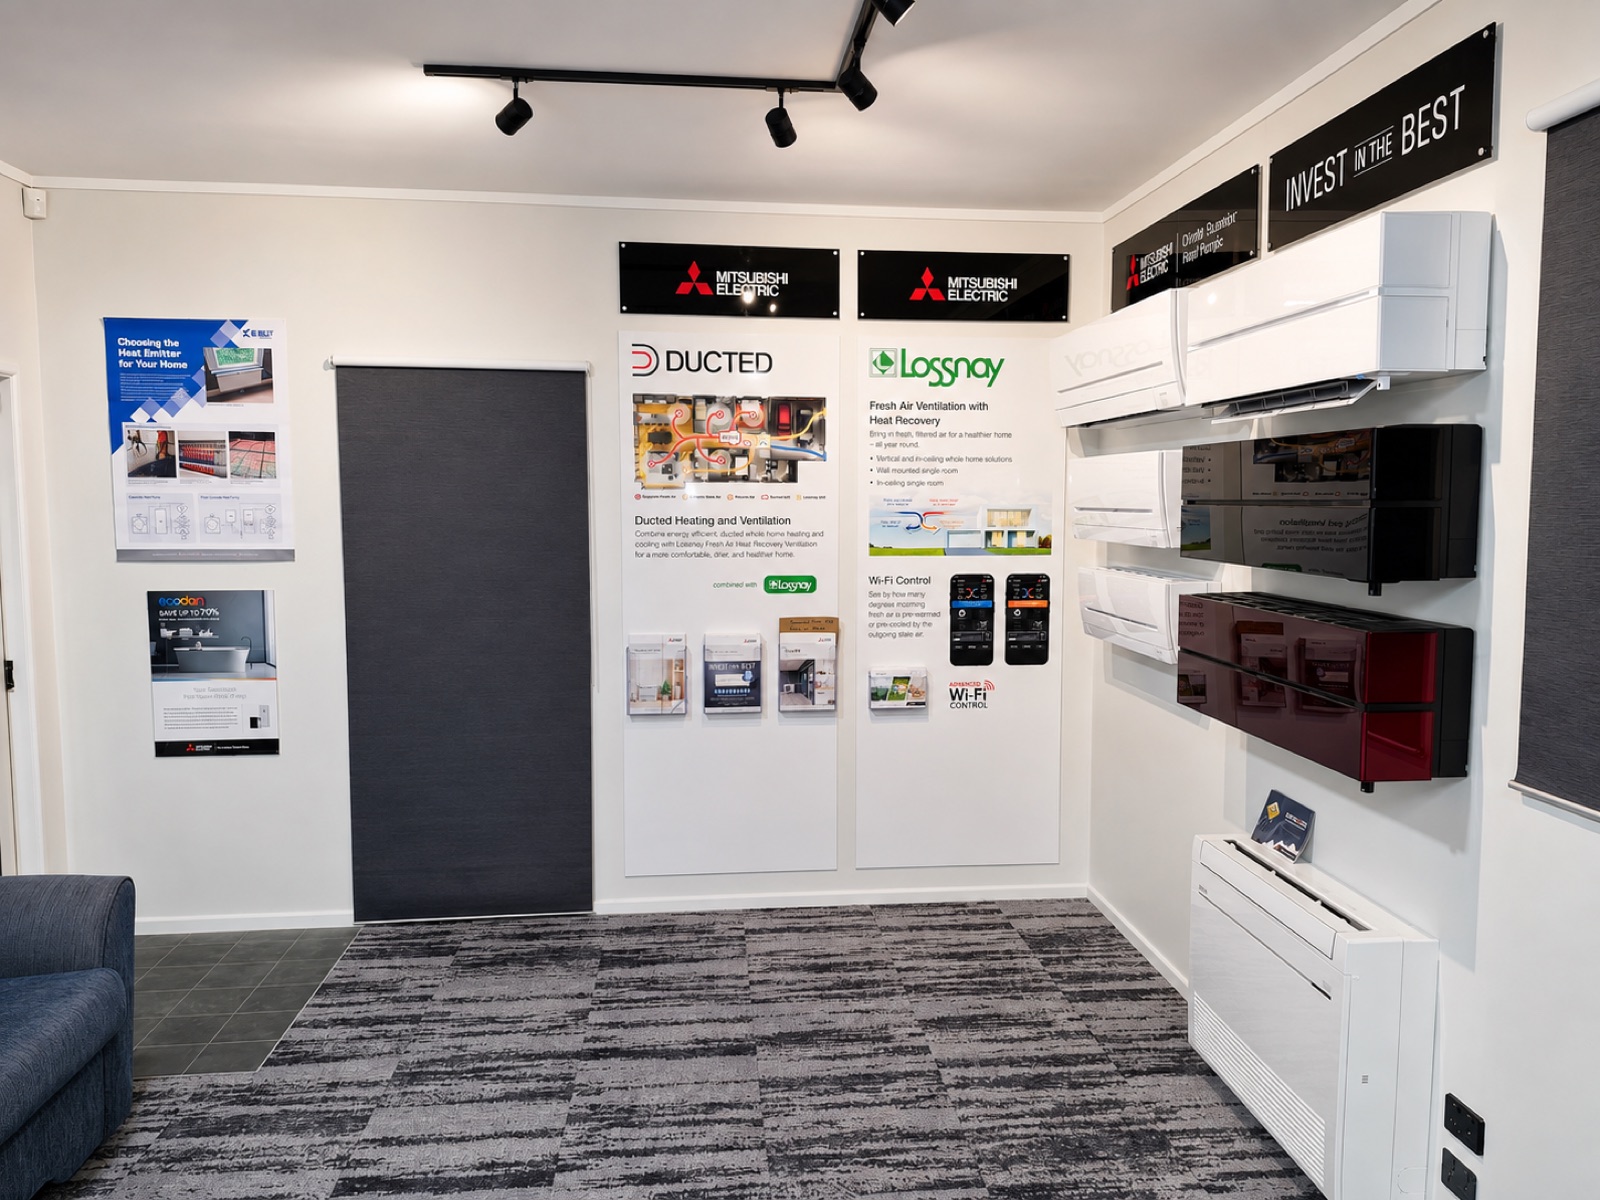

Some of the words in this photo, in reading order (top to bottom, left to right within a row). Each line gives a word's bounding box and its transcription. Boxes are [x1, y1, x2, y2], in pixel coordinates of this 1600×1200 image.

[1286, 148, 1348, 211] INVEST
[1354, 146, 1366, 171] IN
[1369, 132, 1392, 163] THE
[1401, 84, 1465, 156] BEST
[716, 271, 788, 285] MITSUBISHI
[948, 277, 1017, 290] MITSUBISHI
[716, 284, 779, 296] ELECTRIC
[948, 290, 1008, 302] ELECTRIC
[118, 338, 161, 348] Choosing
[164, 338, 179, 347] the
[119, 349, 141, 357] Heat
[144, 349, 181, 358] Emitter
[119, 360, 133, 368] for
[136, 360, 157, 368] Your
[160, 361, 188, 369] Home
[666, 351, 772, 373] DUCTED
[901, 348, 1005, 388] Lossnay
[870, 401, 896, 410] Fresh
[899, 401, 913, 410] Air
[916, 401, 966, 411] Ventilation
[969, 402, 988, 410] with
[870, 416, 893, 424] Heat
[895, 416, 940, 427] Recovery
[870, 431, 886, 439] Bring
[635, 516, 672, 525] Ducted
[675, 516, 714, 527] Heating
[717, 516, 737, 525] and
[740, 516, 791, 525] Ventilation
[869, 576, 893, 585] Wi-Fi
[896, 576, 931, 585] Control
[883, 591, 890, 599] by
[159, 596, 205, 606] ecodan
[200, 608, 219, 616] 70%
[949, 688, 986, 700] Wi-Fi
